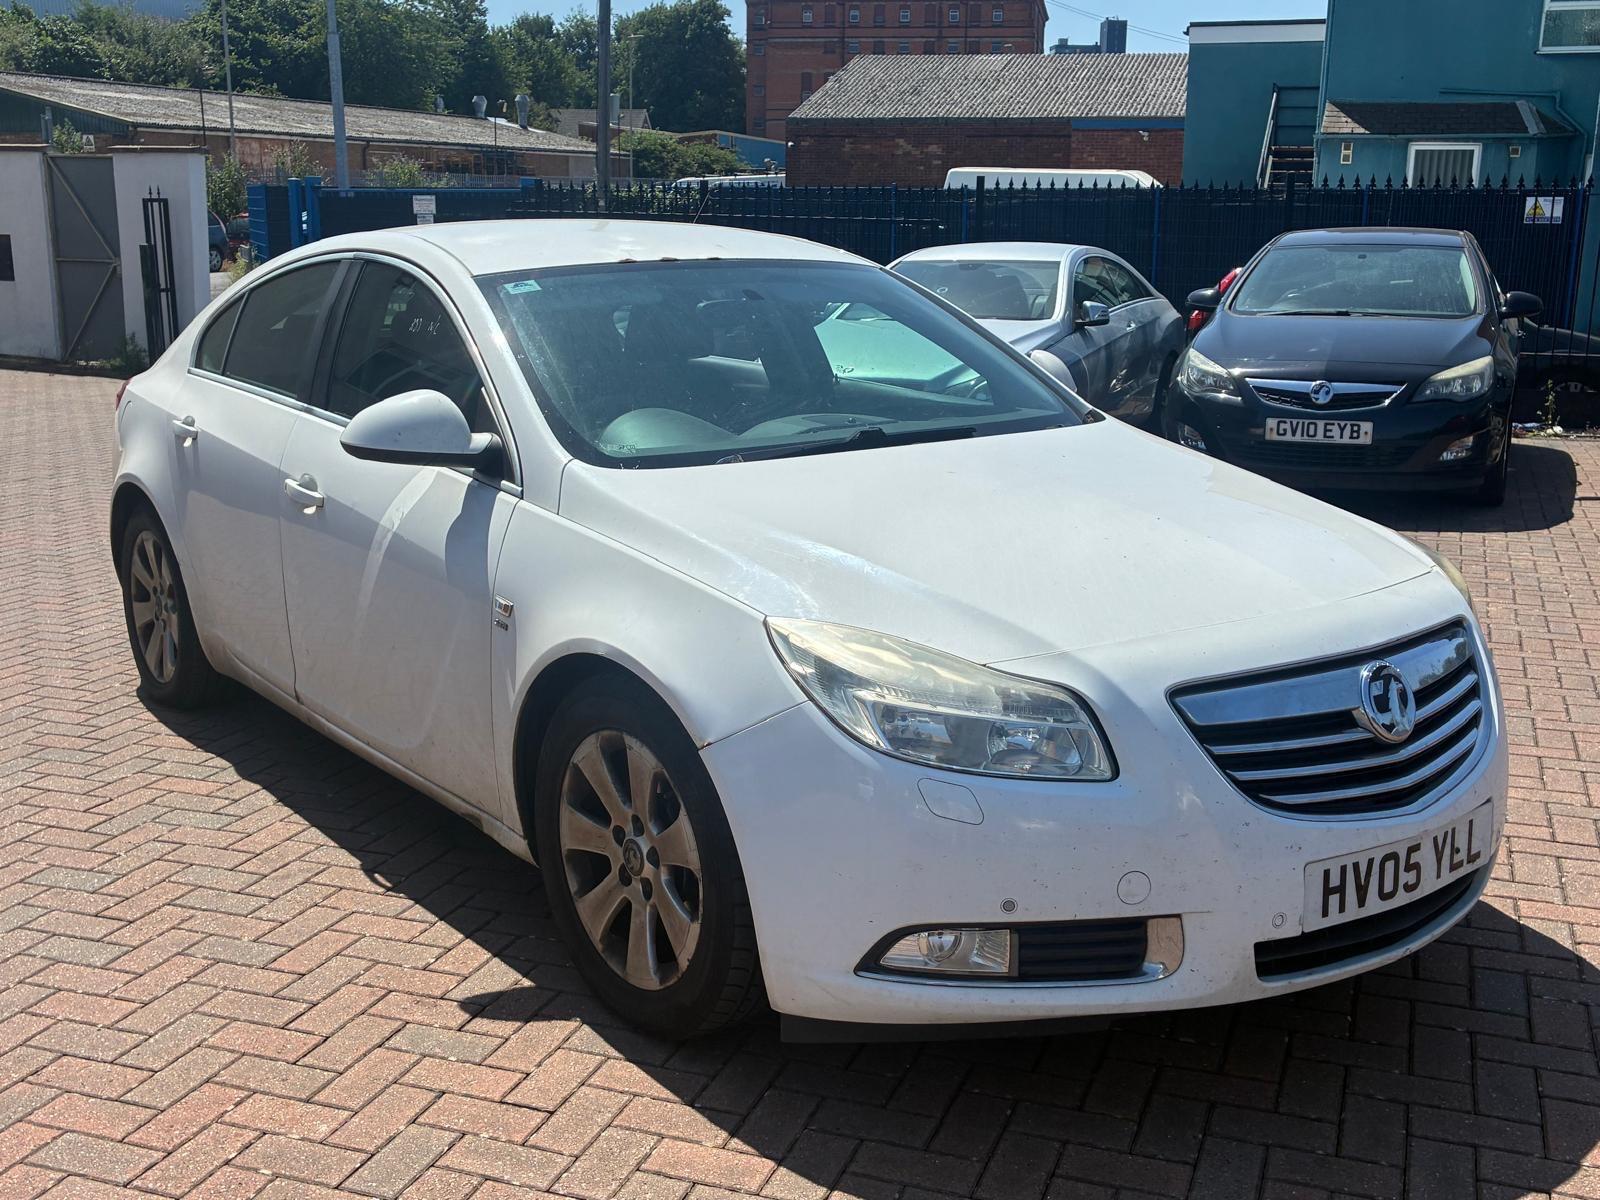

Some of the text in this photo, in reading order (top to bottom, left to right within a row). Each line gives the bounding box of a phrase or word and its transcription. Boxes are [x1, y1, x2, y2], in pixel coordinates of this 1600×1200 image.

[1276, 420, 1361, 440] GV10 EYB
[1321, 818, 1482, 918] HV05 YLL
